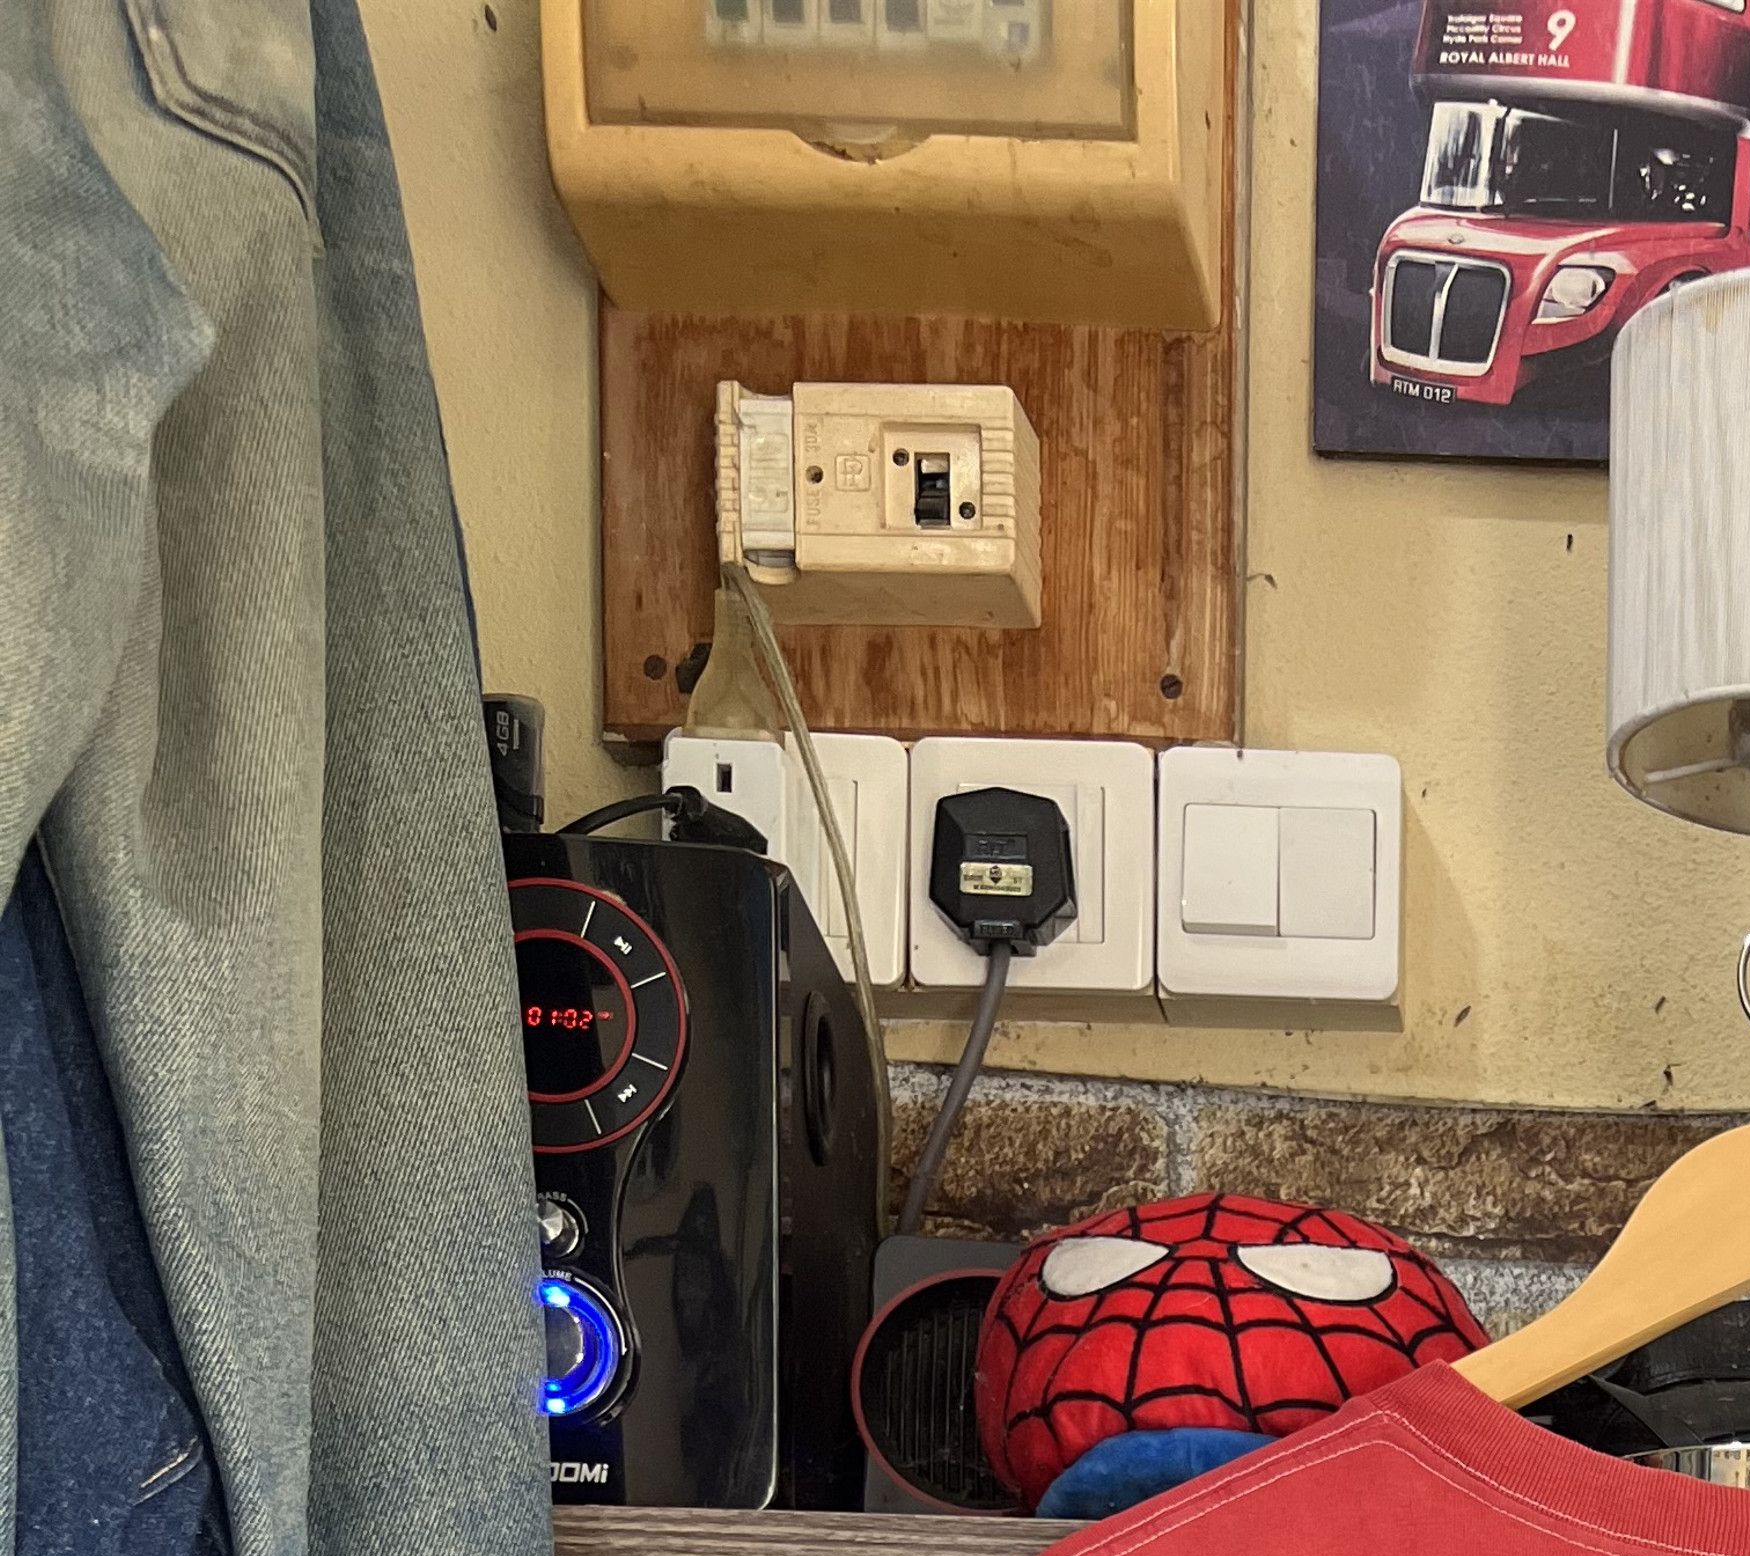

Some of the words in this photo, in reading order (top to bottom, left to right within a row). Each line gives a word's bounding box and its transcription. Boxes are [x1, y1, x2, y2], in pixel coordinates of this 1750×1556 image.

[1547, 9, 1576, 51] 9
[1439, 51, 1485, 64] ROYAL
[1488, 52, 1535, 66] ALBERT
[1537, 53, 1571, 68] HALL
[1423, 386, 1451, 403] 012
[496, 710, 509, 757] 4GB
[527, 1007, 593, 1029] 01:02
